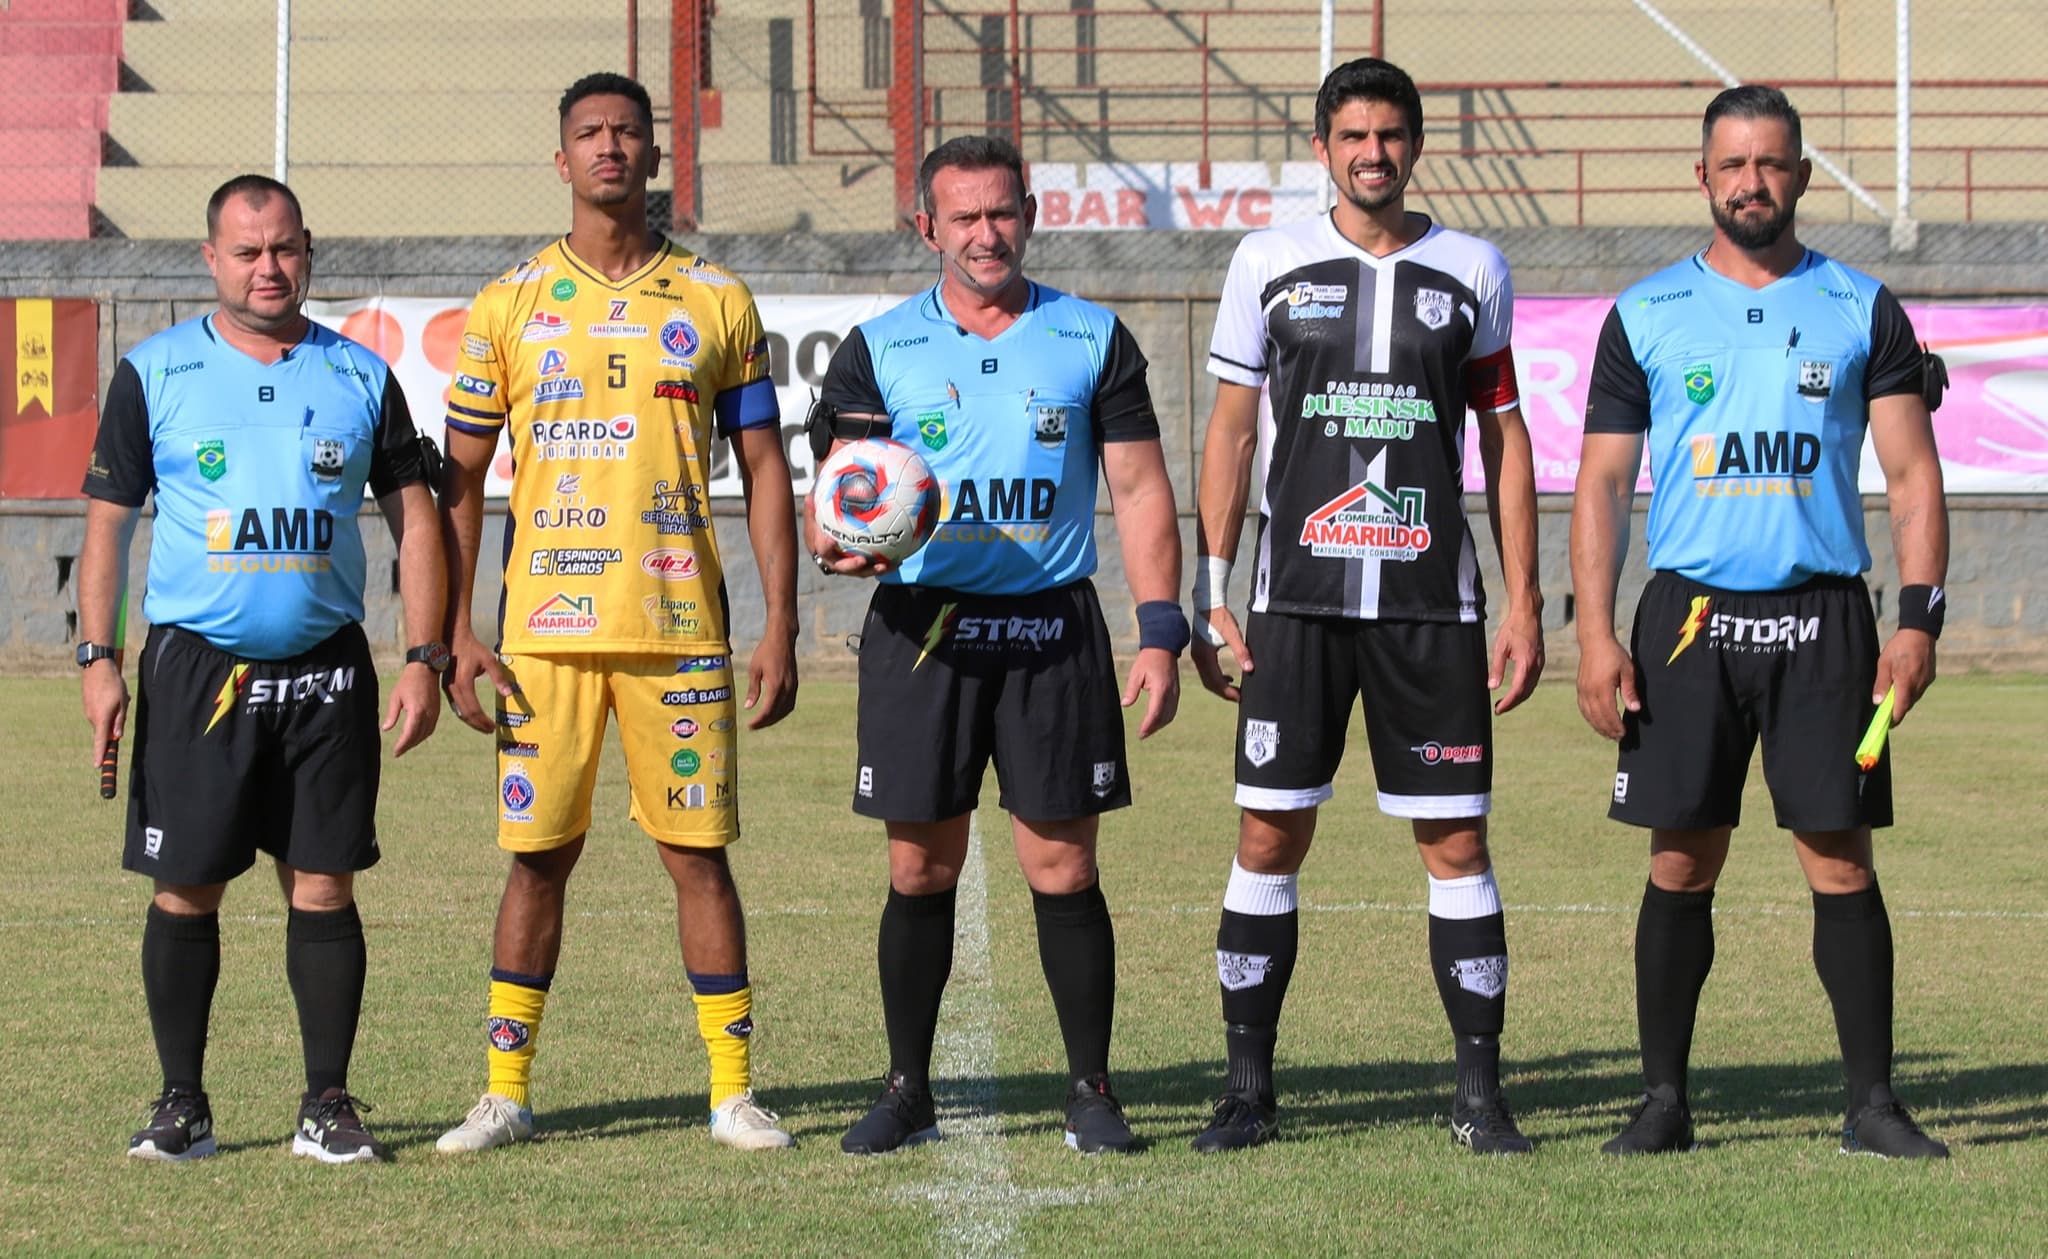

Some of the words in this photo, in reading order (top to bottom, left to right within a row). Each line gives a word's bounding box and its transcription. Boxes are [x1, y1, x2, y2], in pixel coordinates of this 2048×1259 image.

[1042, 189, 1147, 227] BAR
[1177, 187, 1273, 227] WC
[1650, 289, 1692, 304] SICOOB
[889, 336, 928, 348] ICOOB
[164, 361, 204, 377] SICOOB
[607, 354, 626, 389] 5
[1327, 382, 1417, 398] FAZENDAS
[1344, 418, 1415, 440] MADU
[1718, 431, 1820, 474] AMD
[1696, 478, 1812, 498] SEGUROS
[951, 478, 1056, 520] AMD
[534, 508, 606, 528] OURO
[1337, 512, 1396, 524] COMERCIAL
[235, 508, 333, 550] AMD
[823, 523, 904, 544] PENALTY
[1302, 521, 1429, 550] AMARILDO
[556, 550, 621, 562] ESPINDOLA
[1355, 548, 1366, 557] DE
[208, 556, 330, 573] SEGUROS
[556, 562, 603, 574] CARROS
[528, 616, 598, 629] AMARILDO
[671, 613, 700, 629] Mery
[955, 616, 1064, 651] STORM
[1709, 612, 1820, 652] STORM
[248, 666, 355, 704] STORM
[664, 691, 697, 705] JOSÉ
